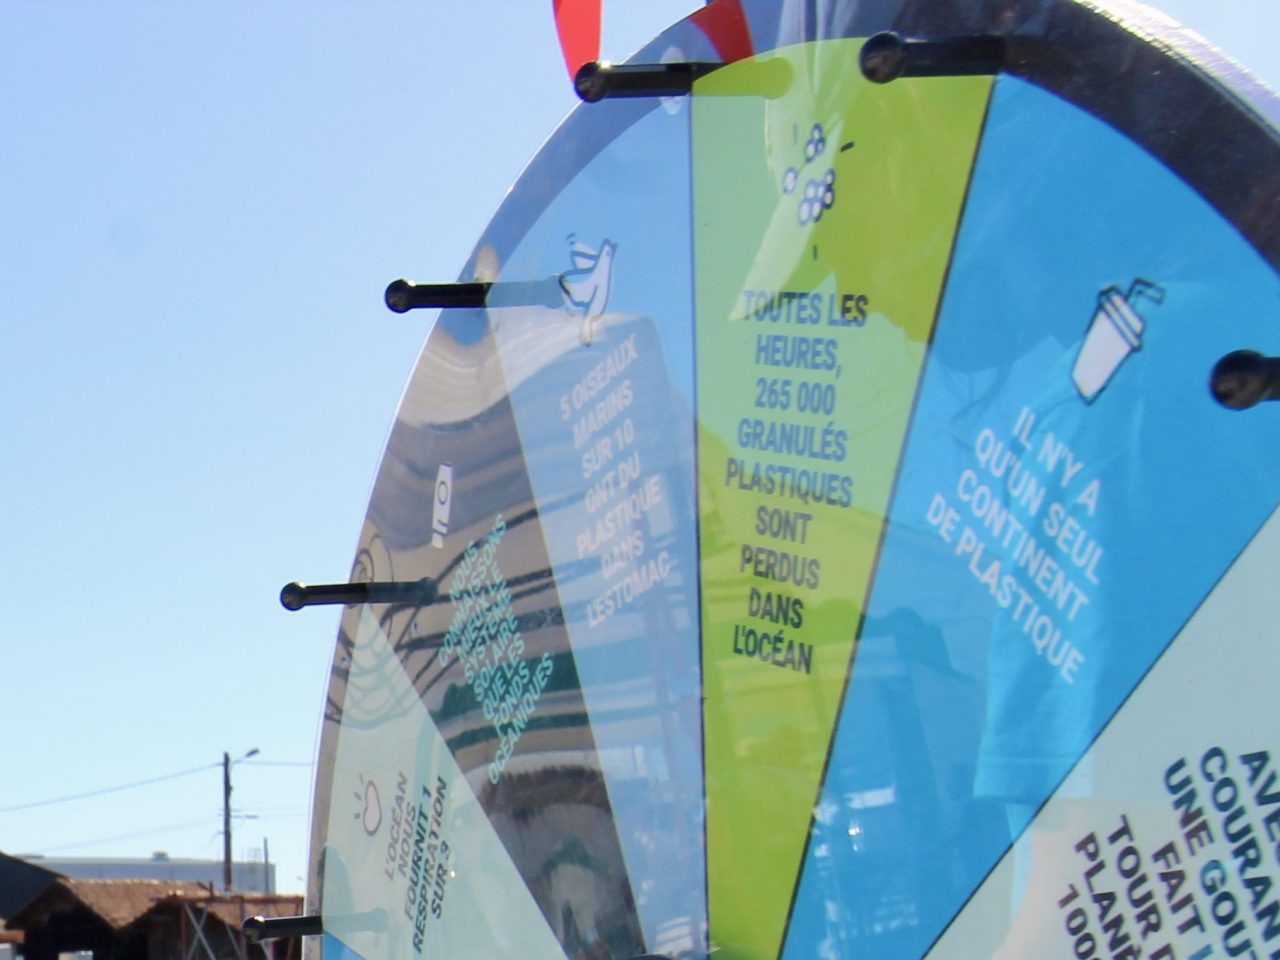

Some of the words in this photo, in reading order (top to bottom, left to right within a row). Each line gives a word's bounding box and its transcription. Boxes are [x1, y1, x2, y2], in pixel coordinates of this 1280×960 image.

[743, 290, 824, 326] TOUTES
[827, 295, 868, 327] LES
[560, 395, 571, 420] 5
[571, 335, 638, 411] OISEAUX
[755, 334, 841, 378] HEURES,
[573, 380, 633, 449] MARINS
[754, 377, 791, 412] 265
[797, 380, 835, 415] 000
[582, 435, 614, 478] SUR
[617, 418, 634, 451] 10
[737, 417, 847, 462] GRANULÉS
[1012, 405, 1035, 451] IL
[1037, 432, 1084, 488] N'Y
[1078, 479, 1101, 517] A
[576, 474, 661, 558] PLASTIQUE
[586, 470, 617, 514] ONT
[617, 452, 640, 488] DU
[726, 457, 853, 508] PLASTIQUES
[975, 428, 1046, 517] QU'UN
[1043, 502, 1103, 585] SEUL
[601, 531, 644, 580] DANS
[756, 506, 812, 545] SONT
[957, 469, 1090, 621] CONTINENT
[740, 545, 819, 589] PERDUS
[926, 492, 961, 543] DE
[955, 527, 1086, 685] PLASTIQUE
[748, 588, 804, 629] DANS
[473, 607, 519, 702] SOLAIRE
[482, 670, 507, 720] QUE
[502, 631, 524, 680] LES
[733, 624, 812, 674] L'OCÉAN
[493, 660, 531, 738] FONDS
[398, 801, 416, 878] NOUS
[1163, 757, 1215, 857] UNE
[405, 802, 429, 921] FOURNIT
[422, 785, 431, 798] 1
[412, 775, 448, 954] RESPIRATION
[431, 862, 449, 919] SUR
[1108, 813, 1163, 941] TOUR
[1152, 840, 1206, 936] FAIT
